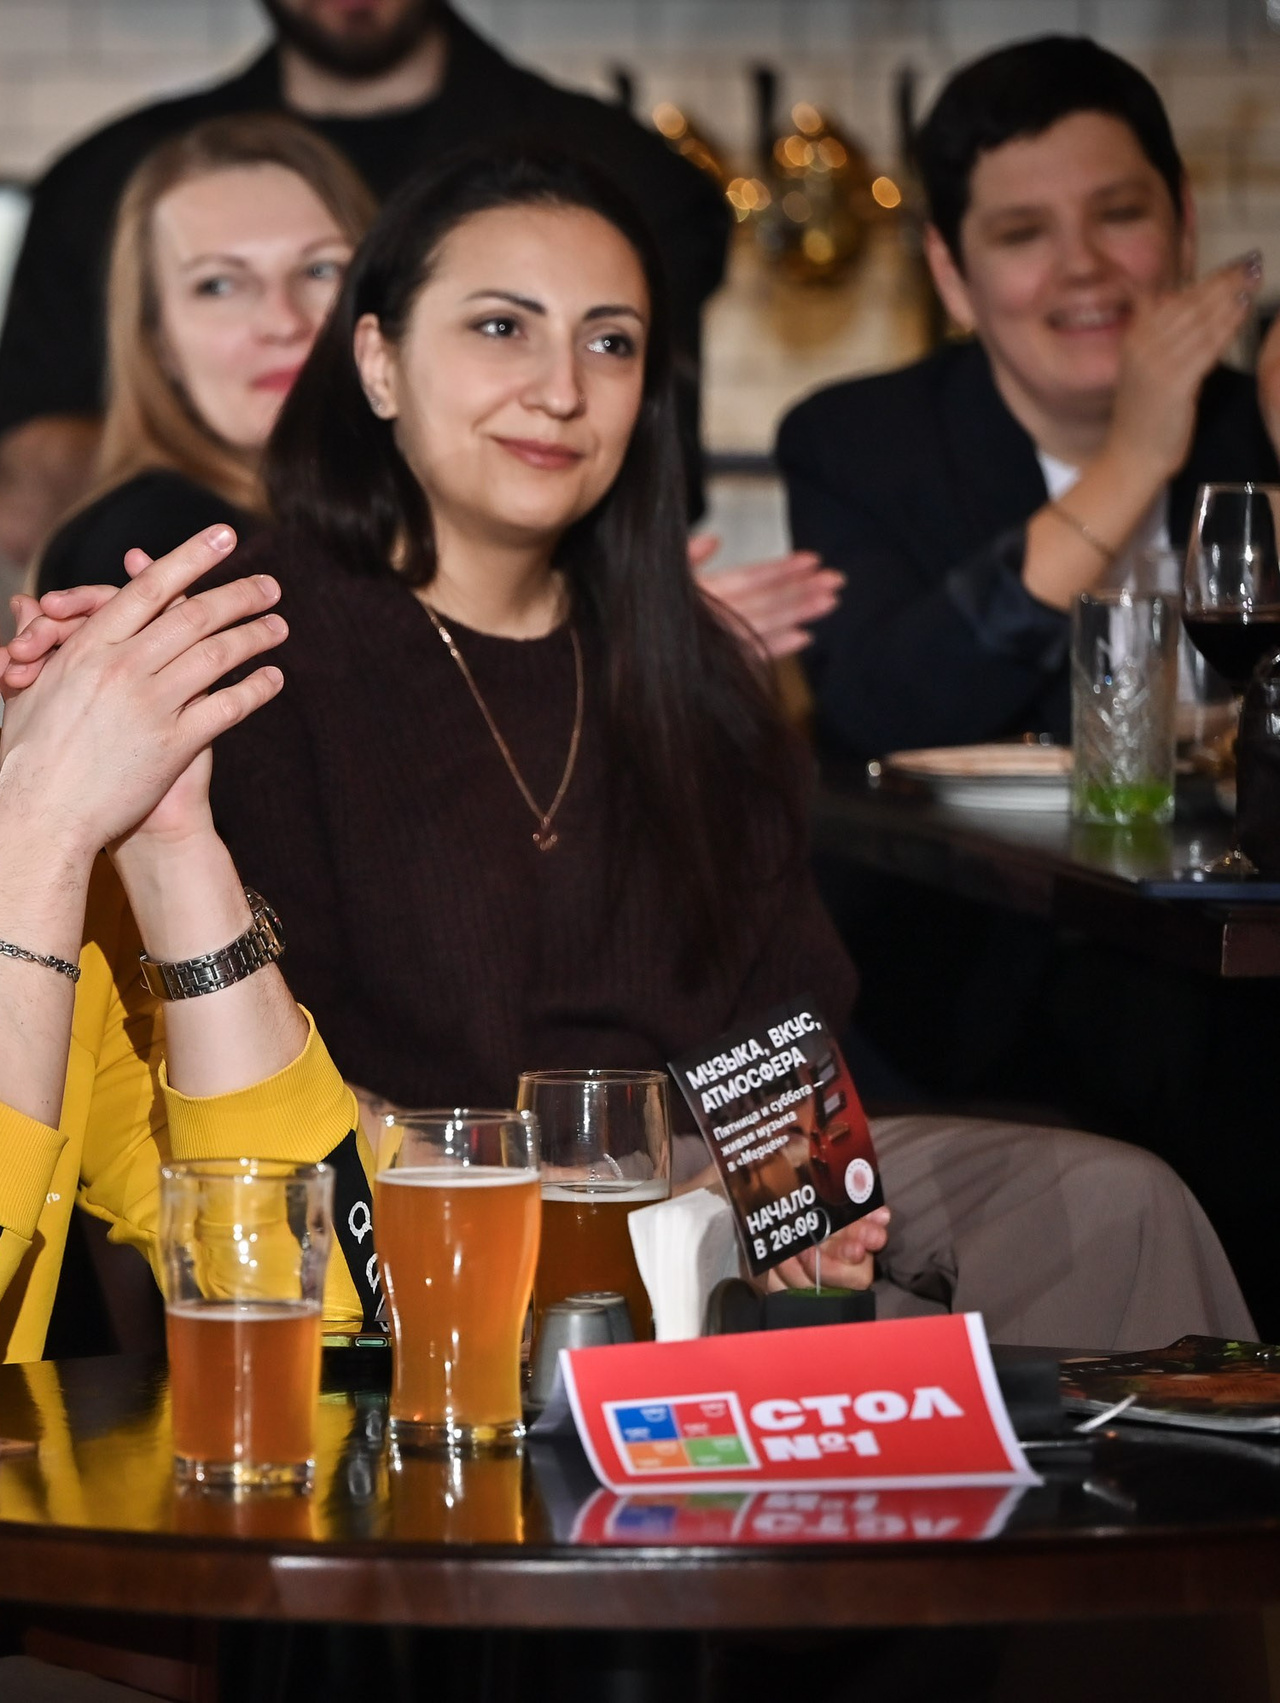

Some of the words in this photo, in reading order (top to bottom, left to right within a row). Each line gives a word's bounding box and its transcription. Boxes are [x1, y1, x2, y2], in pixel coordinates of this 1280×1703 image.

[686, 1038, 771, 1090] МУЗЫКА,
[766, 1011, 822, 1048] ВКУС,
[700, 1046, 807, 1113] АТМОСФЕРА
[712, 1110, 761, 1141] Пятница
[760, 1105, 771, 1118] и
[769, 1083, 813, 1113] суббота
[720, 1131, 758, 1158] живая
[755, 1110, 798, 1140] музыка
[727, 1161, 738, 1173] в
[746, 1184, 816, 1235] НАЧАЛО
[753, 1238, 768, 1261] В
[770, 1210, 819, 1251] 20:00
[751, 1387, 964, 1430] СТОЛ
[761, 1429, 880, 1462] №1
